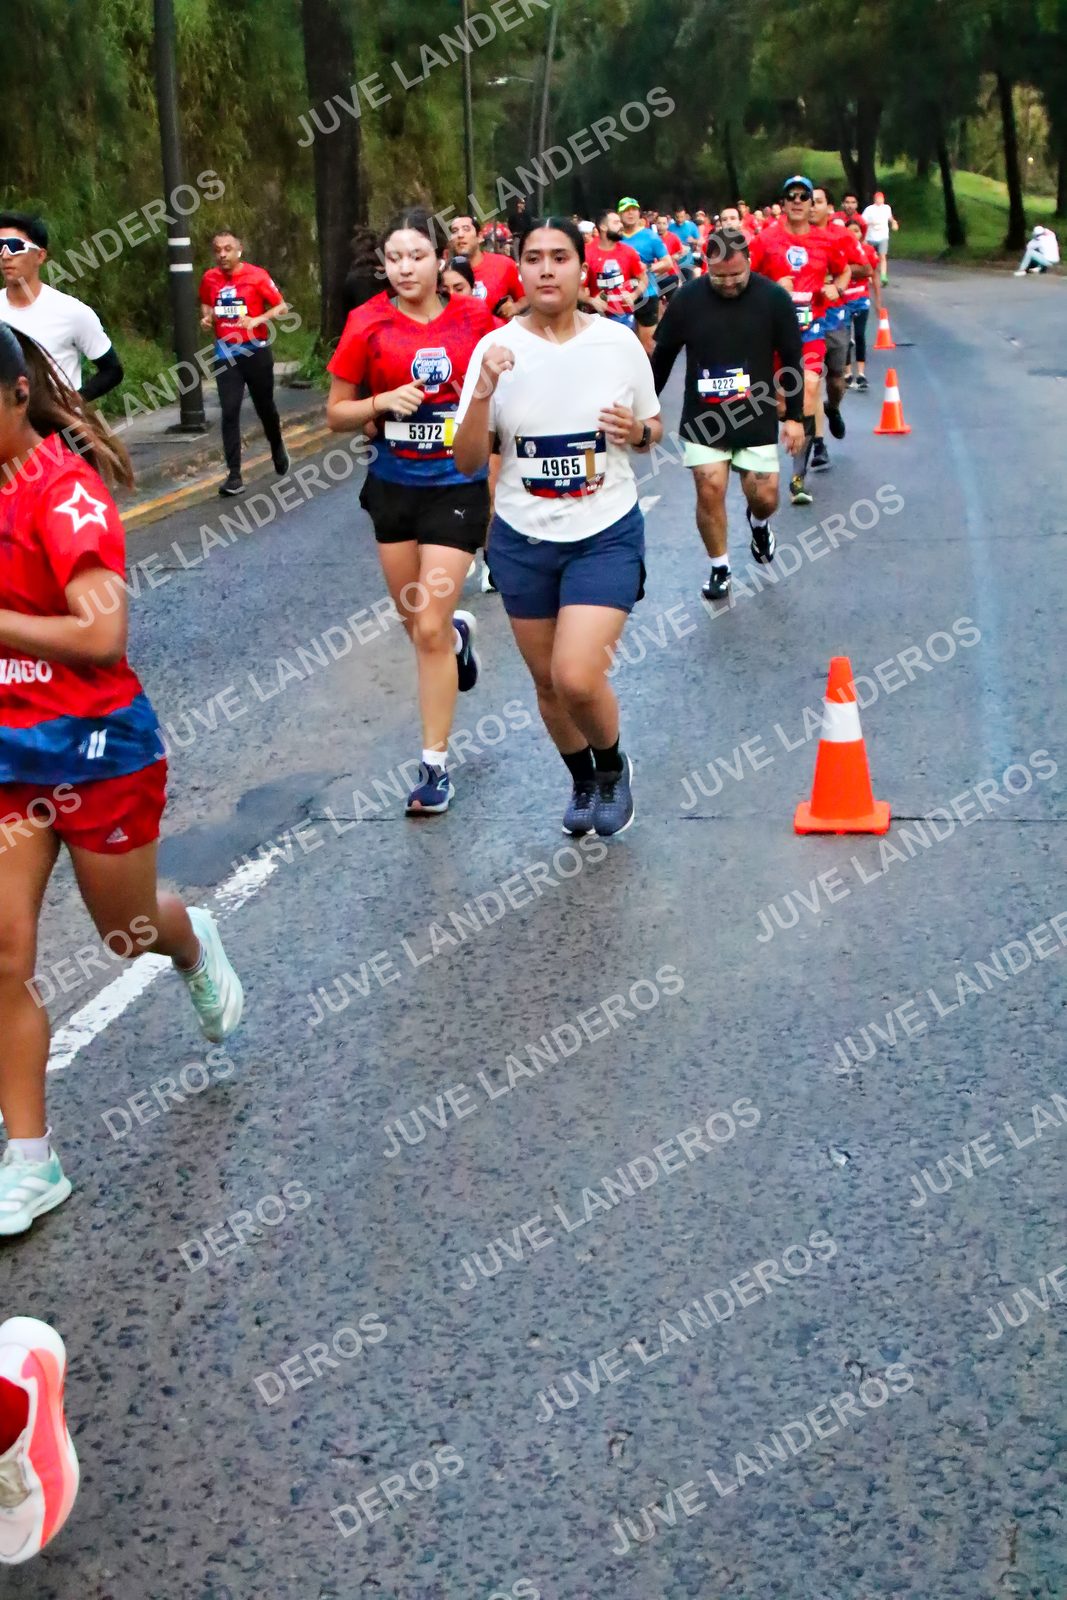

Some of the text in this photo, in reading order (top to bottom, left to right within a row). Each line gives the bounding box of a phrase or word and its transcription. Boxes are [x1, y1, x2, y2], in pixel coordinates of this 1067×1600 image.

[712, 378, 734, 390] 4222
[409, 424, 442, 440] 5372
[542, 457, 580, 477] 4965
